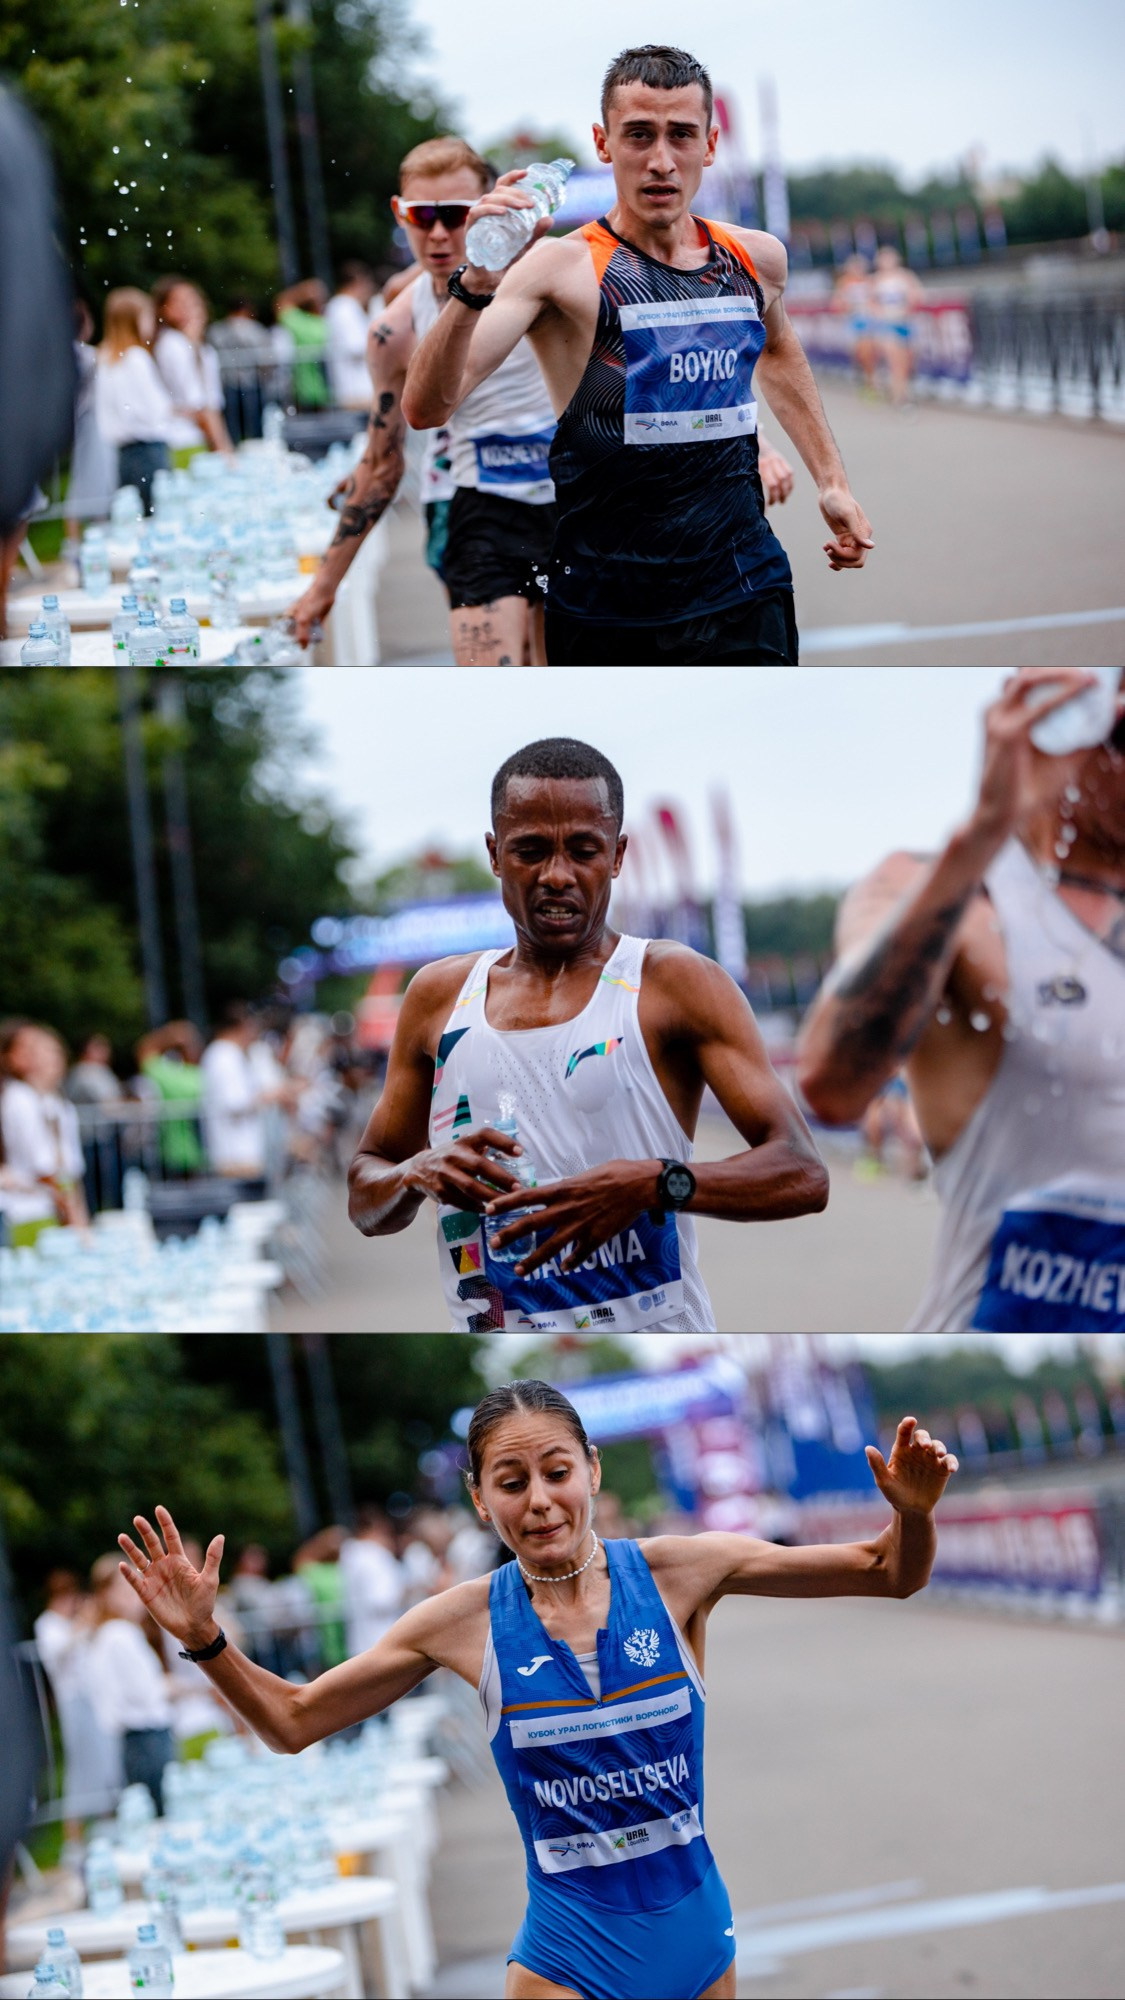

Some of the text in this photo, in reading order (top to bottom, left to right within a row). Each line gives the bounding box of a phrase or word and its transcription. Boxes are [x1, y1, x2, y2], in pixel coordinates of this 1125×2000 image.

[669, 348, 738, 383] BOYKO
[705, 414, 722, 423] URAL
[590, 1307, 615, 1320] URAL
[528, 1703, 679, 1740] КУБОК УРАЛ ЛОГИСТИКИ ВОРОНОВО
[534, 1753, 690, 1808] NOVOSELTSEVA
[626, 1828, 649, 1841] URAL
